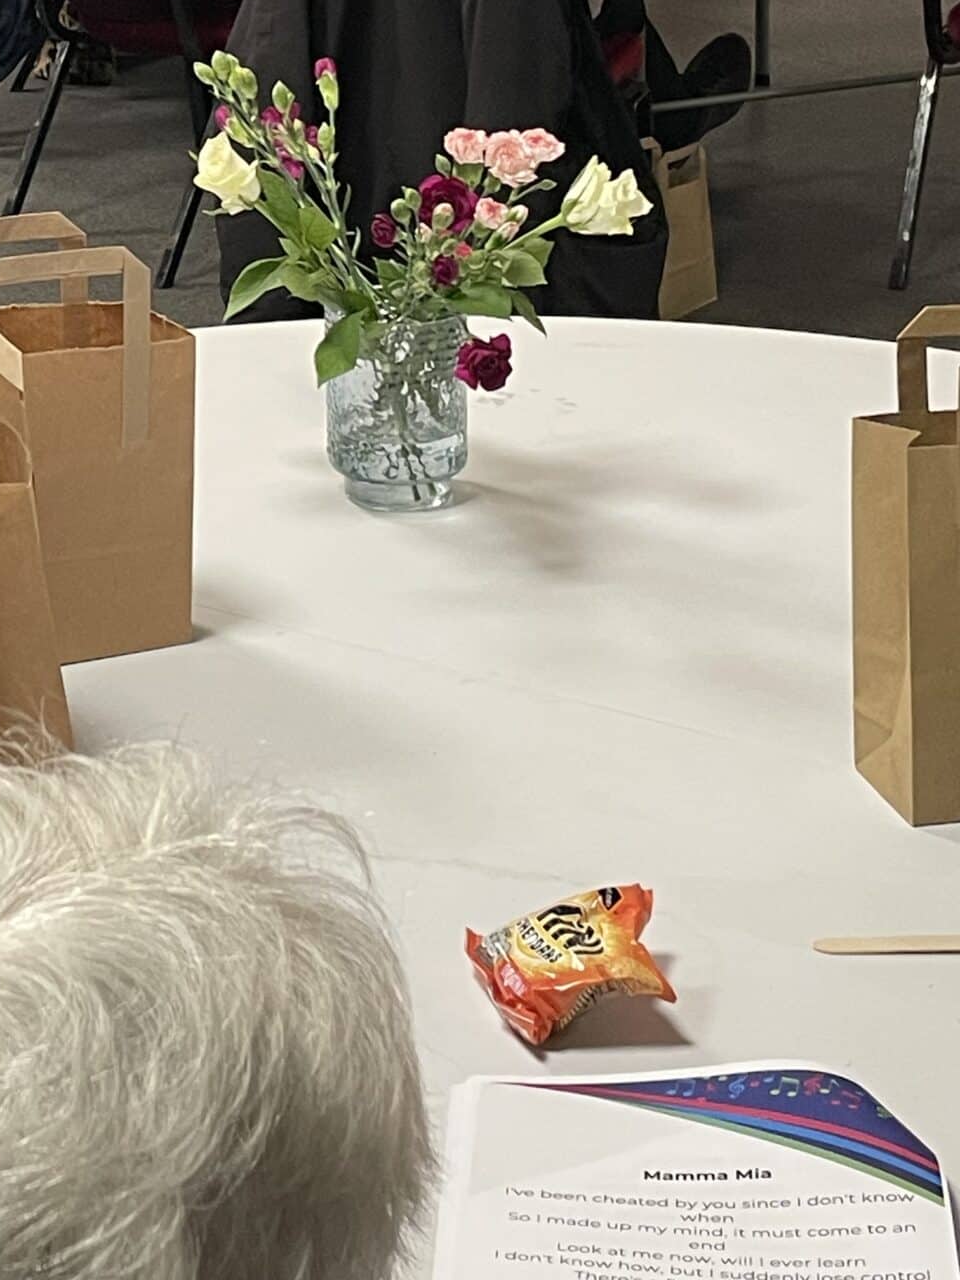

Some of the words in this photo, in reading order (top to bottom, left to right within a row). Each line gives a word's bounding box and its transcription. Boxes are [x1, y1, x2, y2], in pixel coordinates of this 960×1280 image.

[643, 1169, 729, 1182] Mamma
[735, 1167, 773, 1181] Mia
[505, 1186, 535, 1198] I've
[540, 1189, 588, 1203] been
[592, 1194, 669, 1208] cheated
[675, 1199, 698, 1211] by
[702, 1200, 736, 1212] you
[742, 1197, 792, 1209] since
[807, 1193, 856, 1207] don't
[862, 1191, 915, 1204] know
[507, 1211, 532, 1223] So
[547, 1215, 601, 1229] made
[607, 1221, 632, 1232] up
[637, 1224, 668, 1236] my
[673, 1226, 728, 1239] mind,
[734, 1227, 746, 1238] it
[752, 1227, 803, 1239] must
[807, 1226, 862, 1238] come
[867, 1224, 887, 1235] to
[893, 1223, 917, 1234] an
[680, 1213, 735, 1224] when
[557, 1242, 602, 1255] Look
[608, 1247, 626, 1257] at
[632, 1250, 664, 1261] me
[669, 1253, 716, 1266] now,
[720, 1255, 753, 1267] will
[769, 1259, 811, 1269] ever
[817, 1257, 867, 1268] learn
[688, 1241, 726, 1251] end
[505, 1251, 553, 1265] don't
[559, 1255, 613, 1269] know
[618, 1260, 665, 1275] how,
[670, 1265, 704, 1278] but
[860, 1269, 931, 1280] control
[574, 1270, 643, 1280] There'
